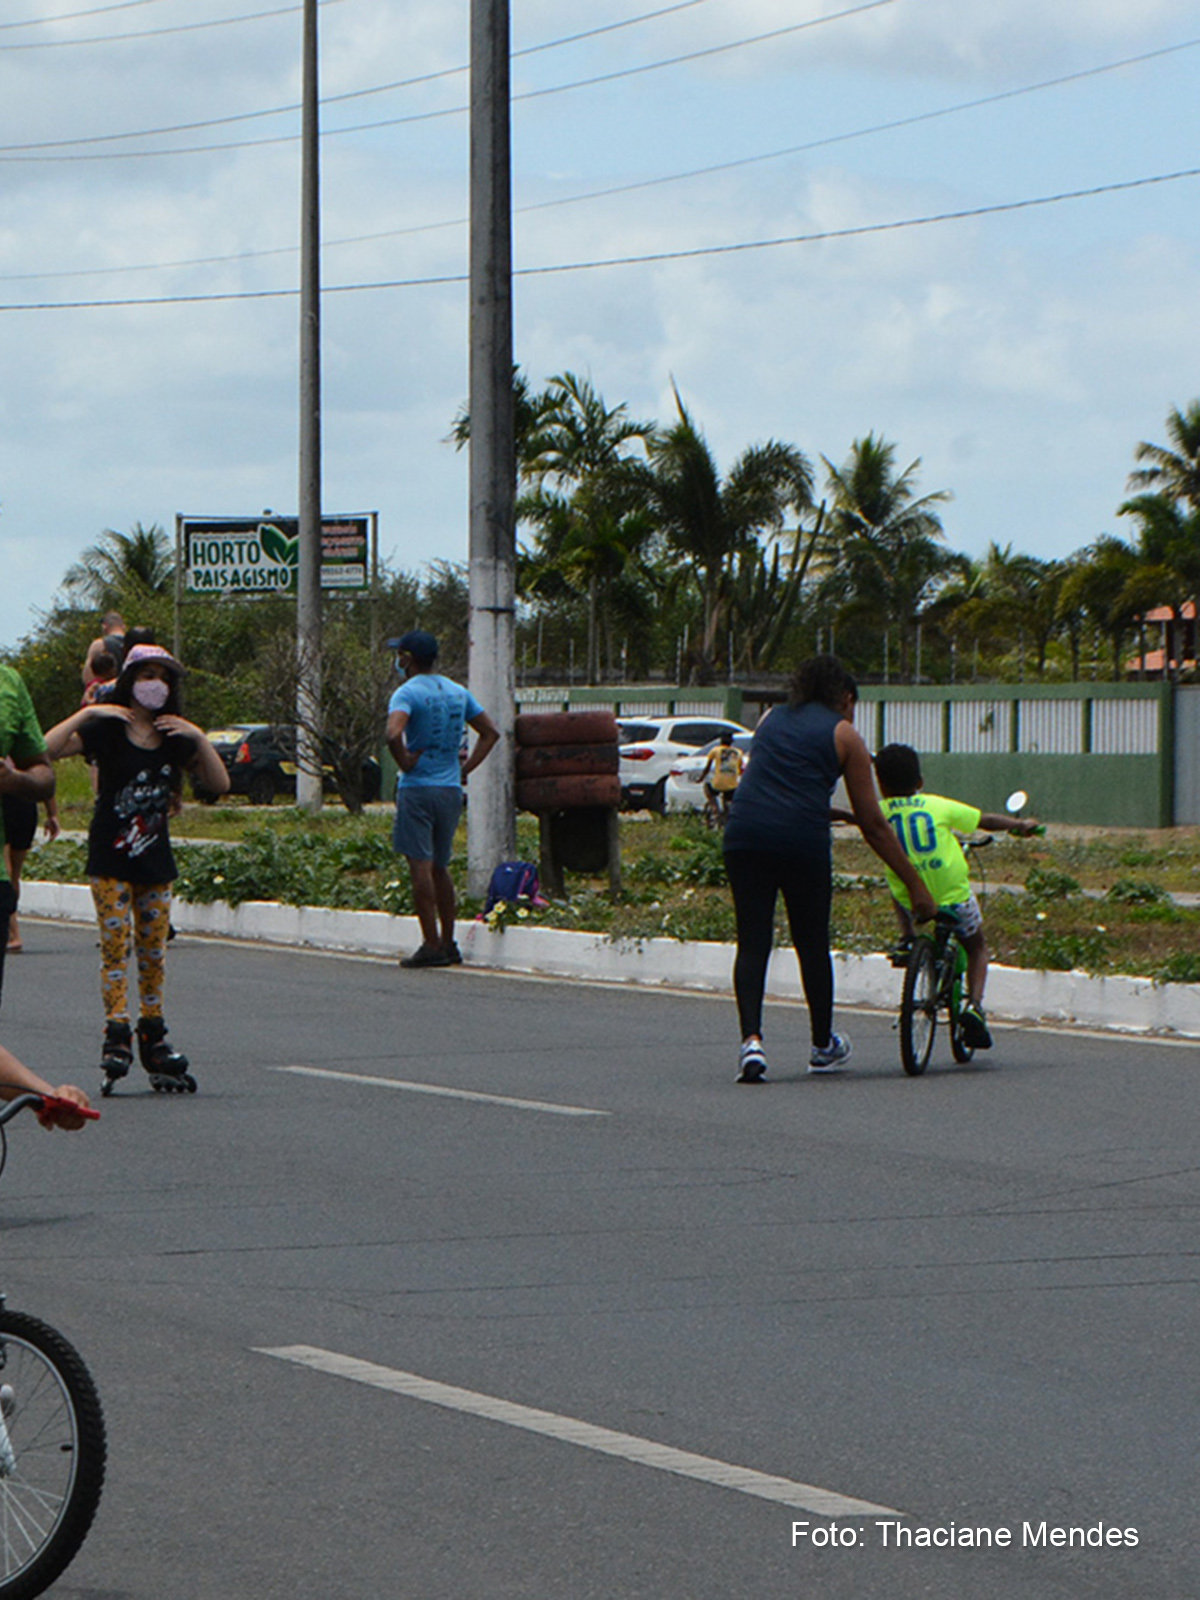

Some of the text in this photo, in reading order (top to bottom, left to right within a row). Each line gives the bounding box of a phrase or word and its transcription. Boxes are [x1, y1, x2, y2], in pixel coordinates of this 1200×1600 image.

[192, 541, 261, 565] HORTO
[192, 567, 290, 588] PAISAGISMO
[888, 811, 937, 854] 10
